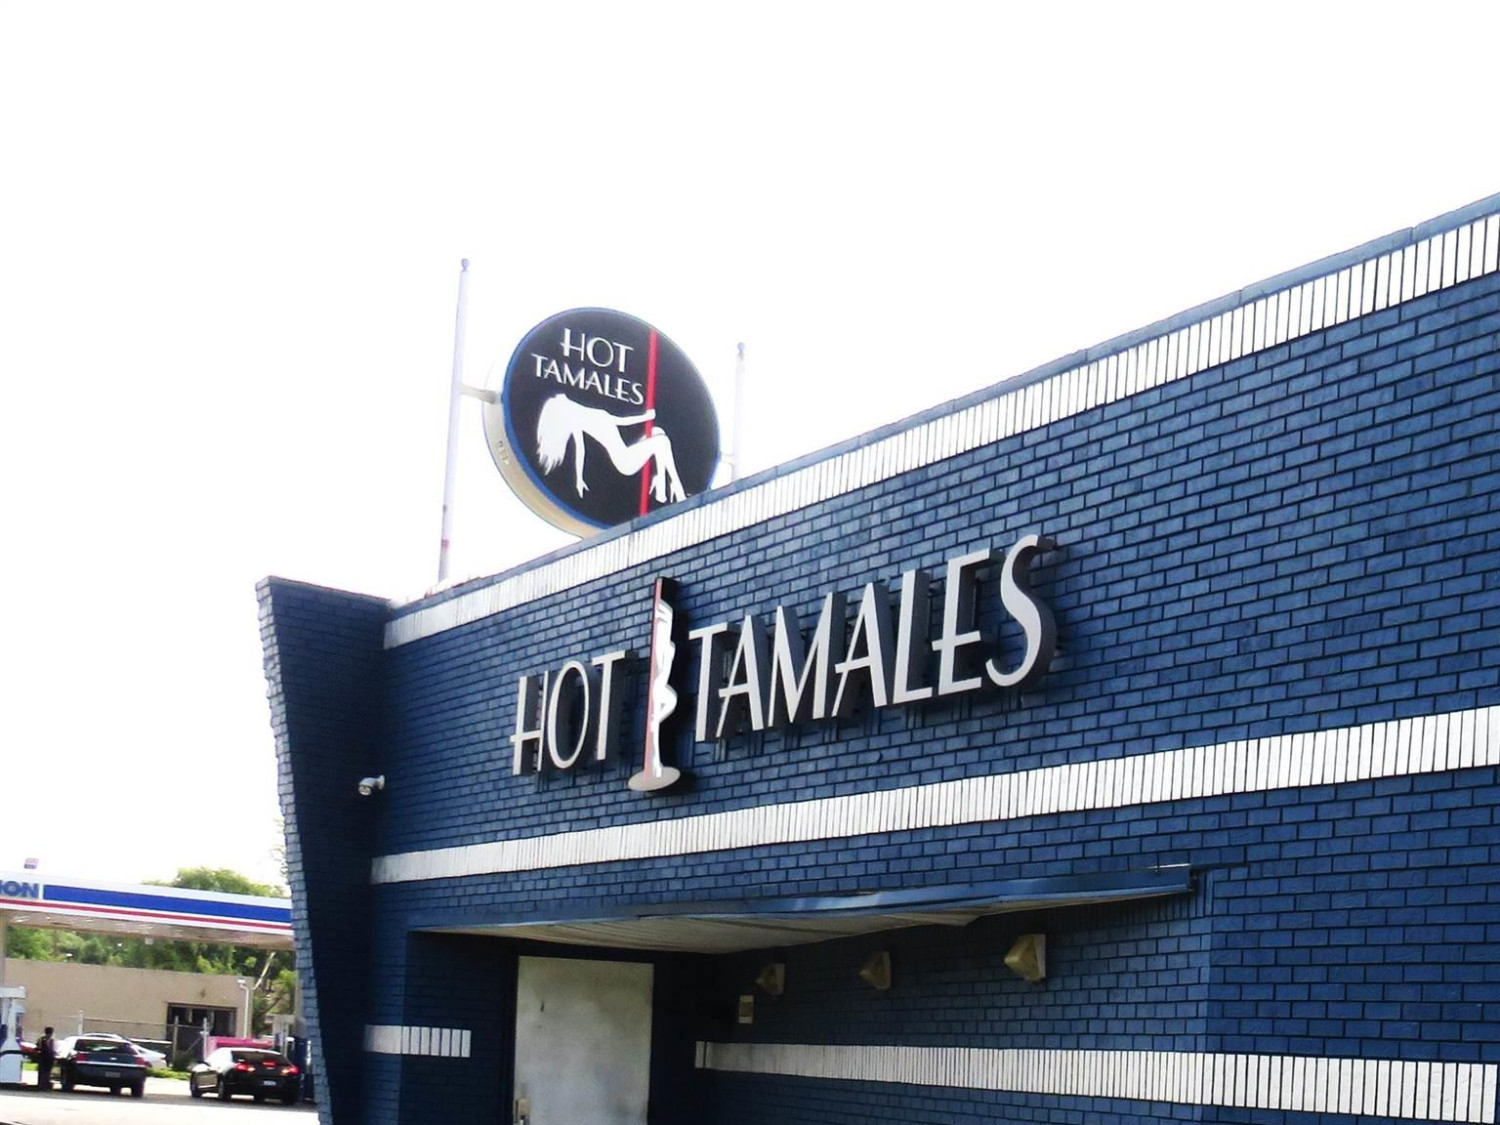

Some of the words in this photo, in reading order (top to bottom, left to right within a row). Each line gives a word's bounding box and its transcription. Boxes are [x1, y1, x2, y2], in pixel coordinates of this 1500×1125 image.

[561, 328, 634, 373] HOT
[531, 353, 645, 405] TAMALES
[510, 651, 632, 776] HOT
[688, 534, 1053, 742] TAMALES
[0, 879, 39, 899] ON
